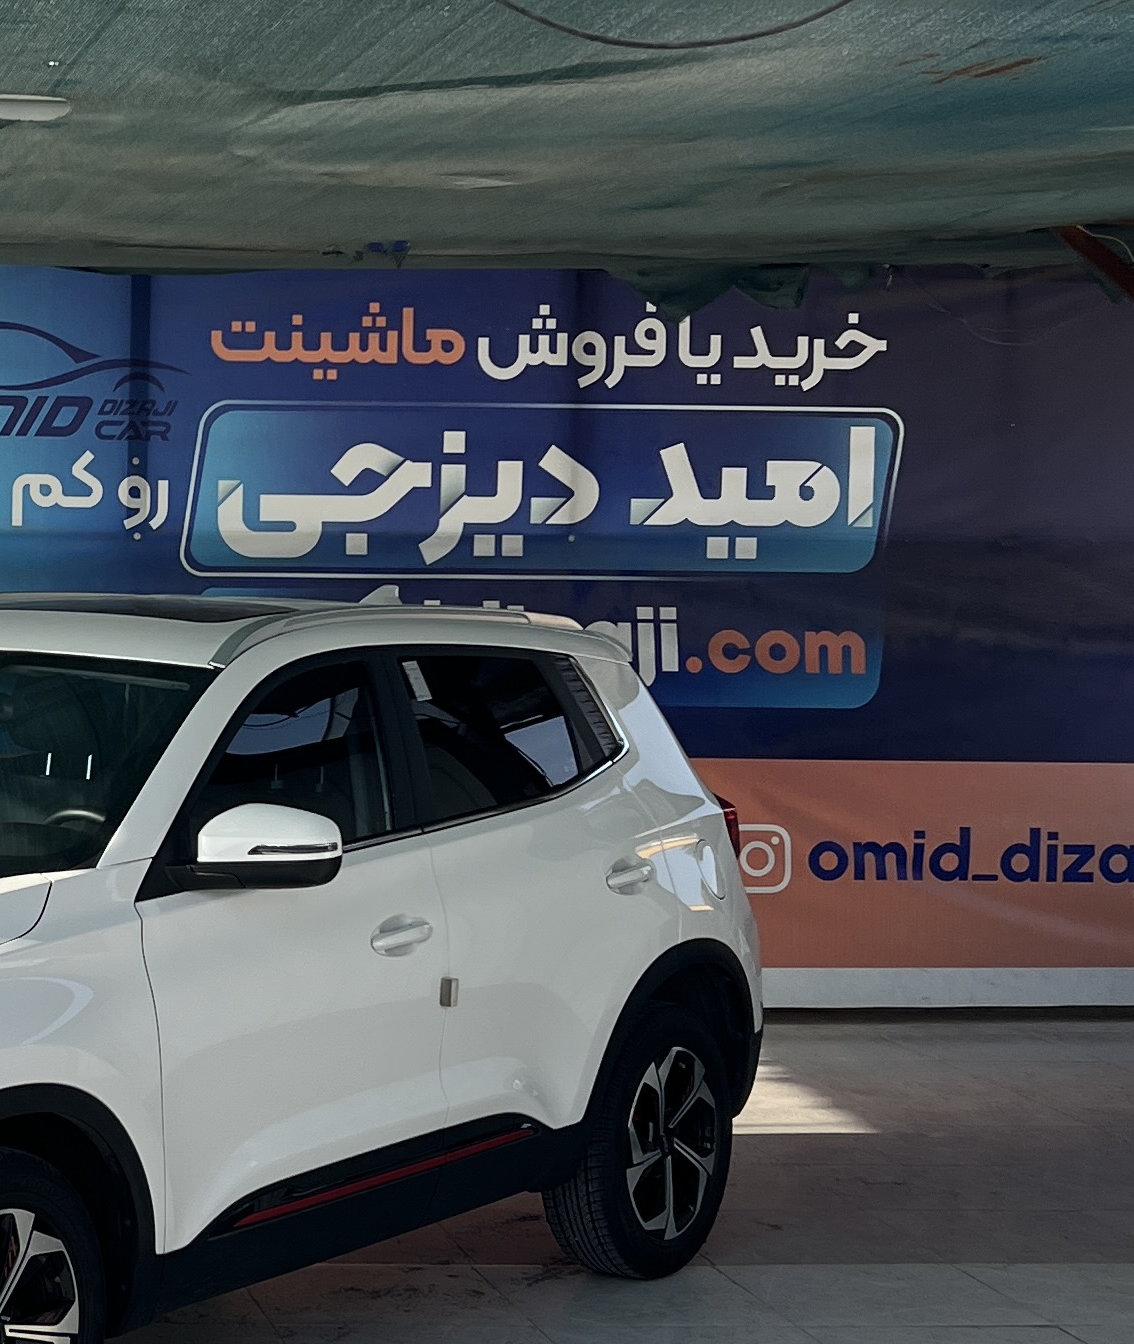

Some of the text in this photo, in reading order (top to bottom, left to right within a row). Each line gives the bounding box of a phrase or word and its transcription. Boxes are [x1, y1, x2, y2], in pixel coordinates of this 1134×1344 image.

[210, 302, 888, 392] خرید یا فروش ماشینت
[94, 419, 172, 442] CAR
[96, 398, 179, 418] DIZAJI
[11, 449, 104, 528] کم
[117, 474, 169, 531] رو
[216, 426, 876, 566] امید دیزجی
